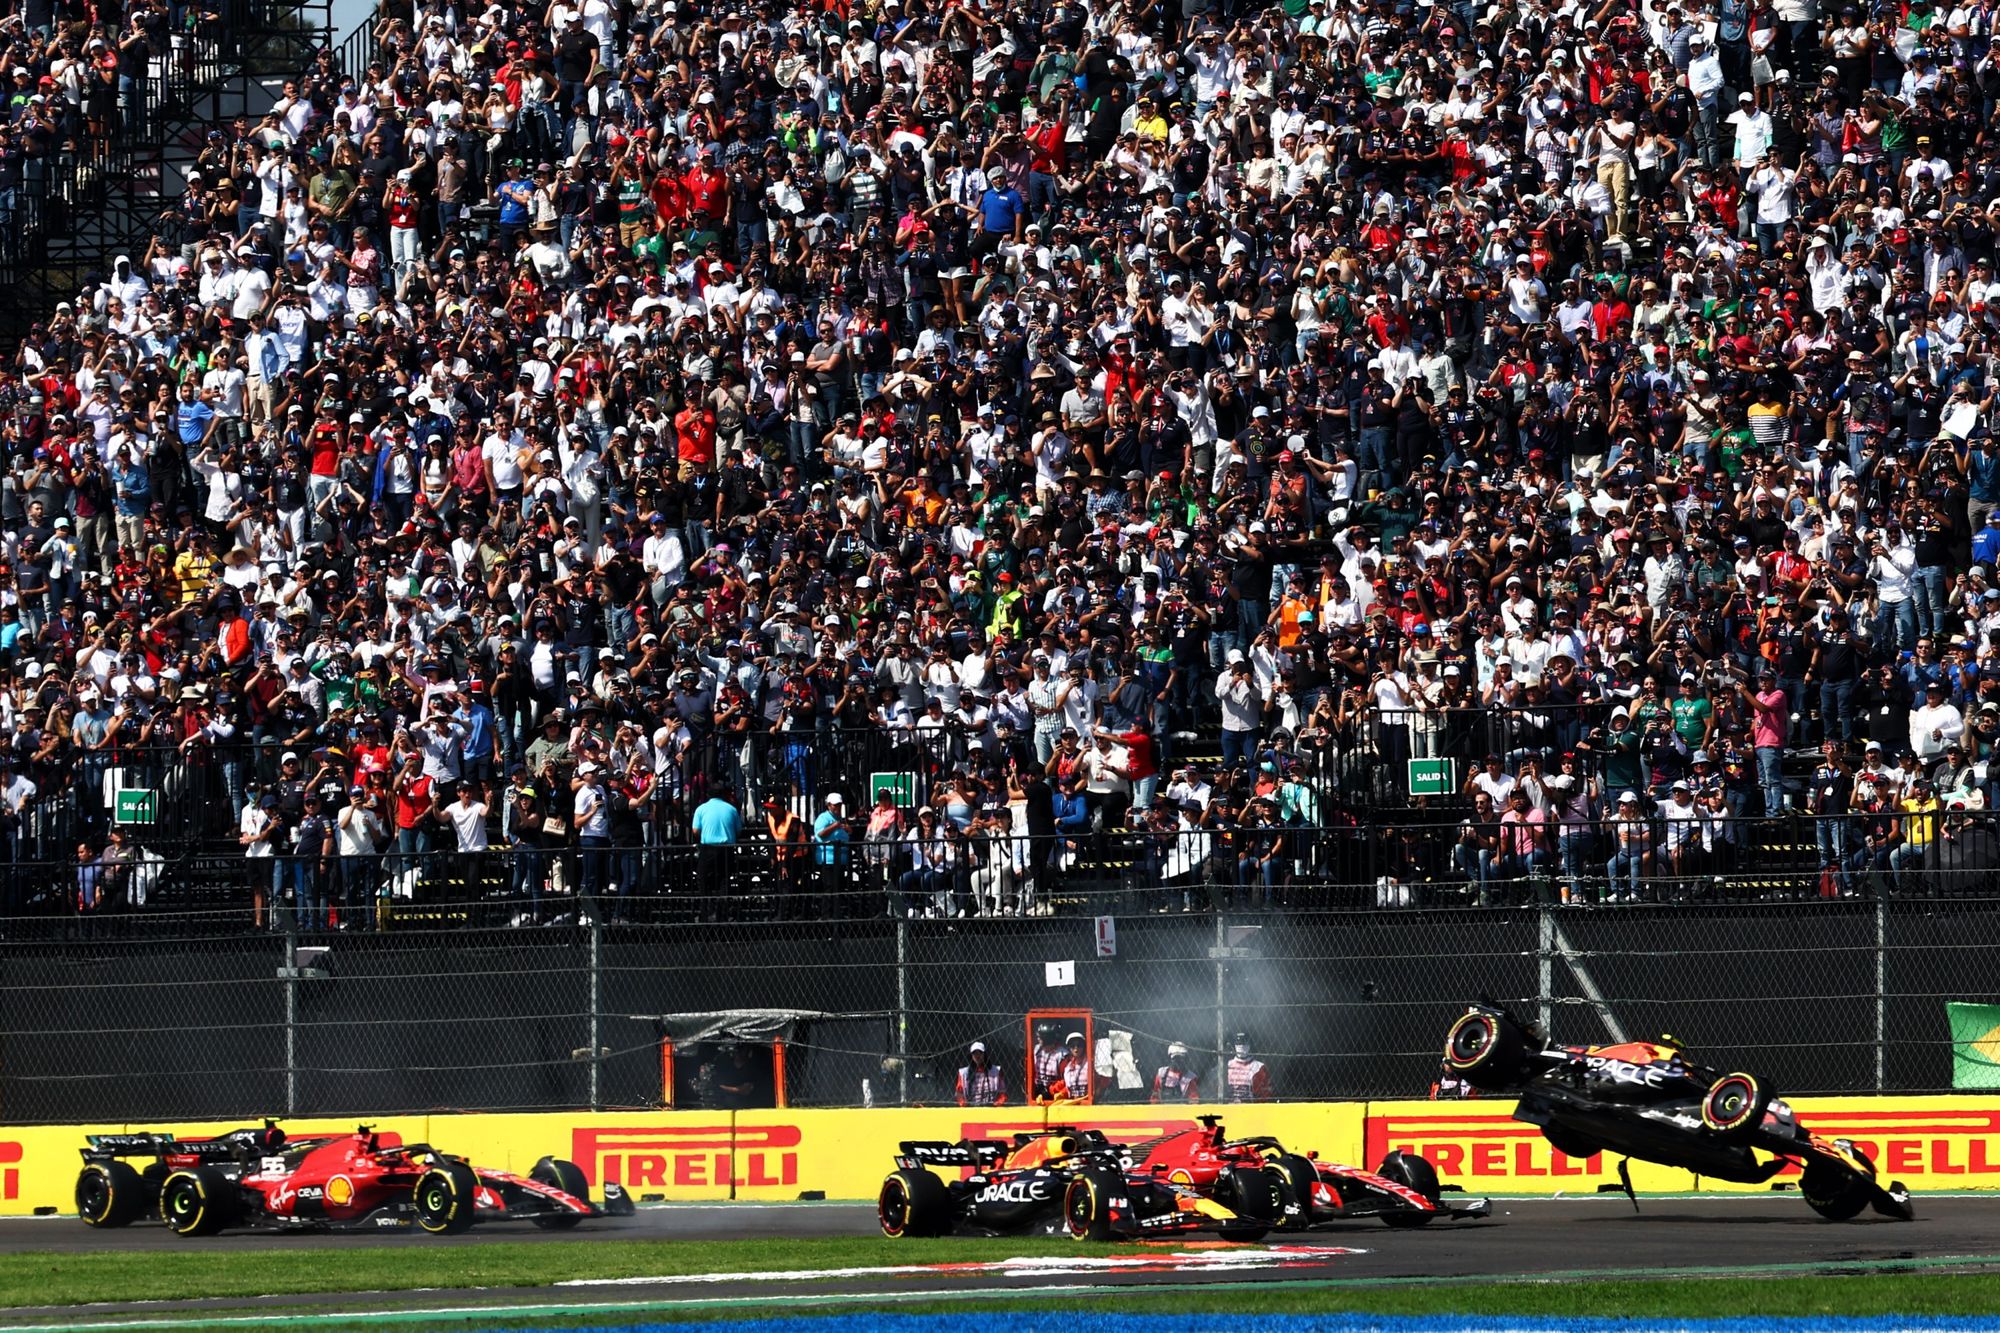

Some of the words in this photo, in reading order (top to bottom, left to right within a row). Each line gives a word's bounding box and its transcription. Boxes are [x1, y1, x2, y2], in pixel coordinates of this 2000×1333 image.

[1057, 967, 1062, 980] 1
[572, 1125, 801, 1187] PIRELLI
[261, 1156, 286, 1174] 55
[297, 1187, 323, 1198] CEVA
